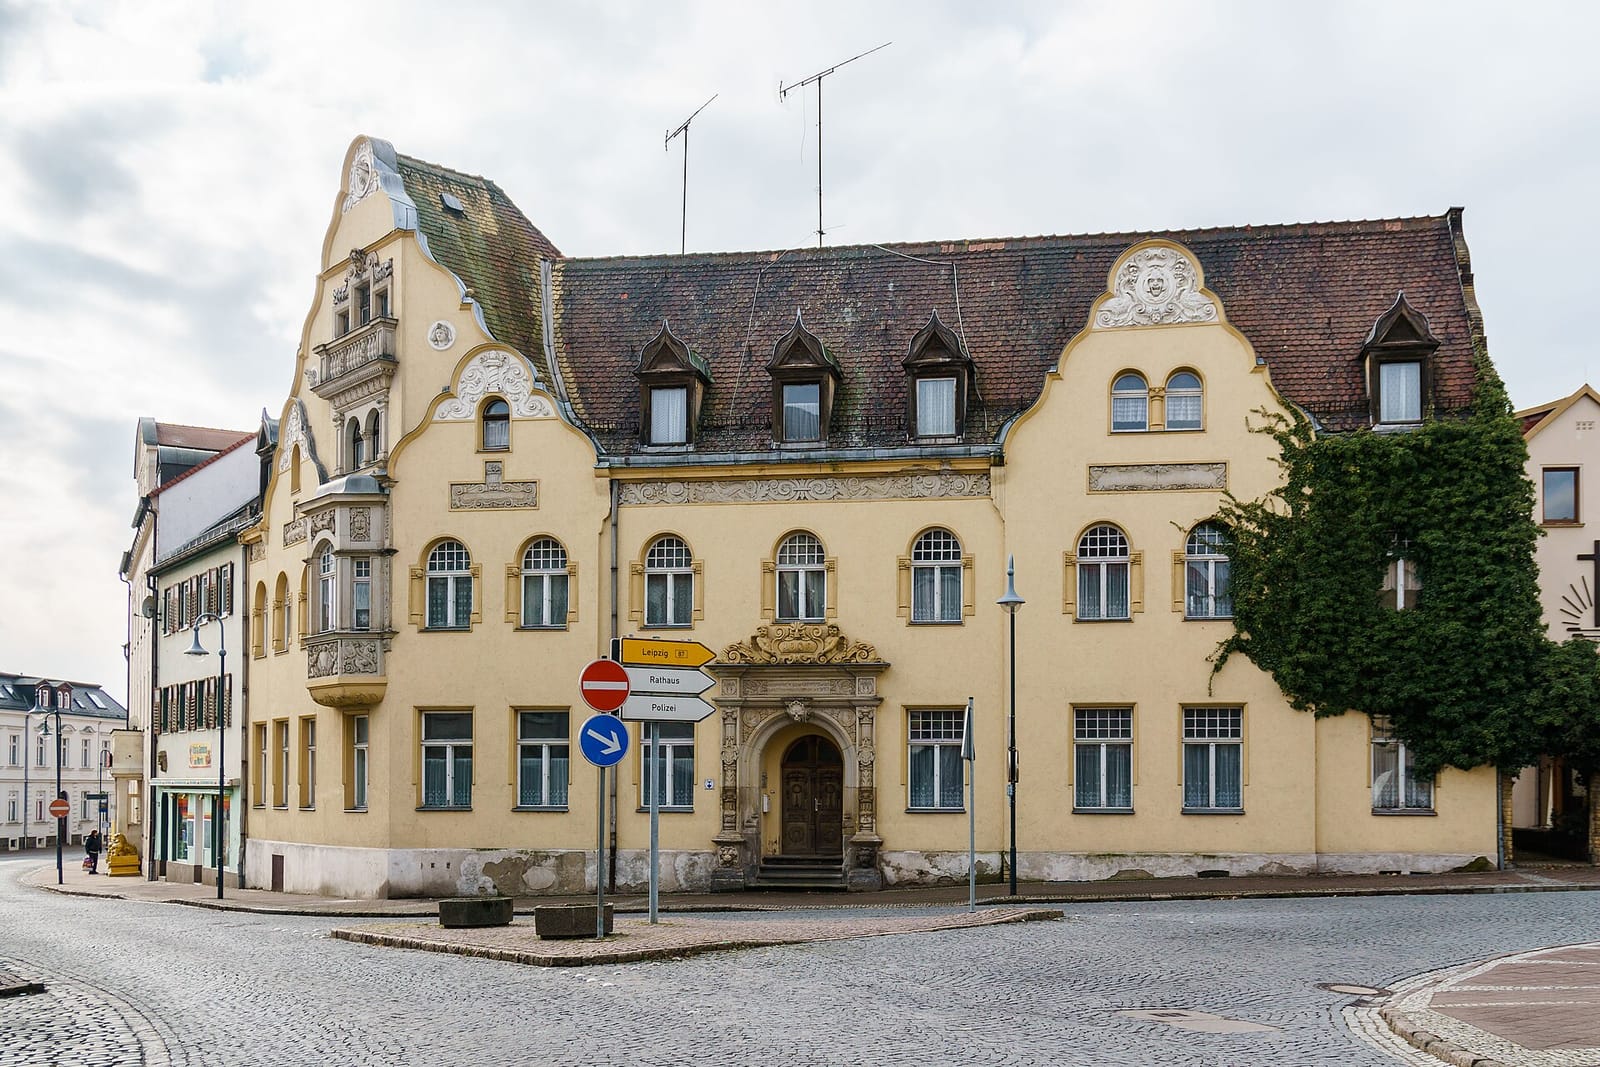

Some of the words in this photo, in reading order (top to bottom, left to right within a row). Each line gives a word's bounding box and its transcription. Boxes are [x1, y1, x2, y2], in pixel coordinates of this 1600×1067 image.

[642, 648, 669, 658] Leipzig
[649, 676, 680, 684] Rathaus
[651, 704, 677, 712] Polizei
